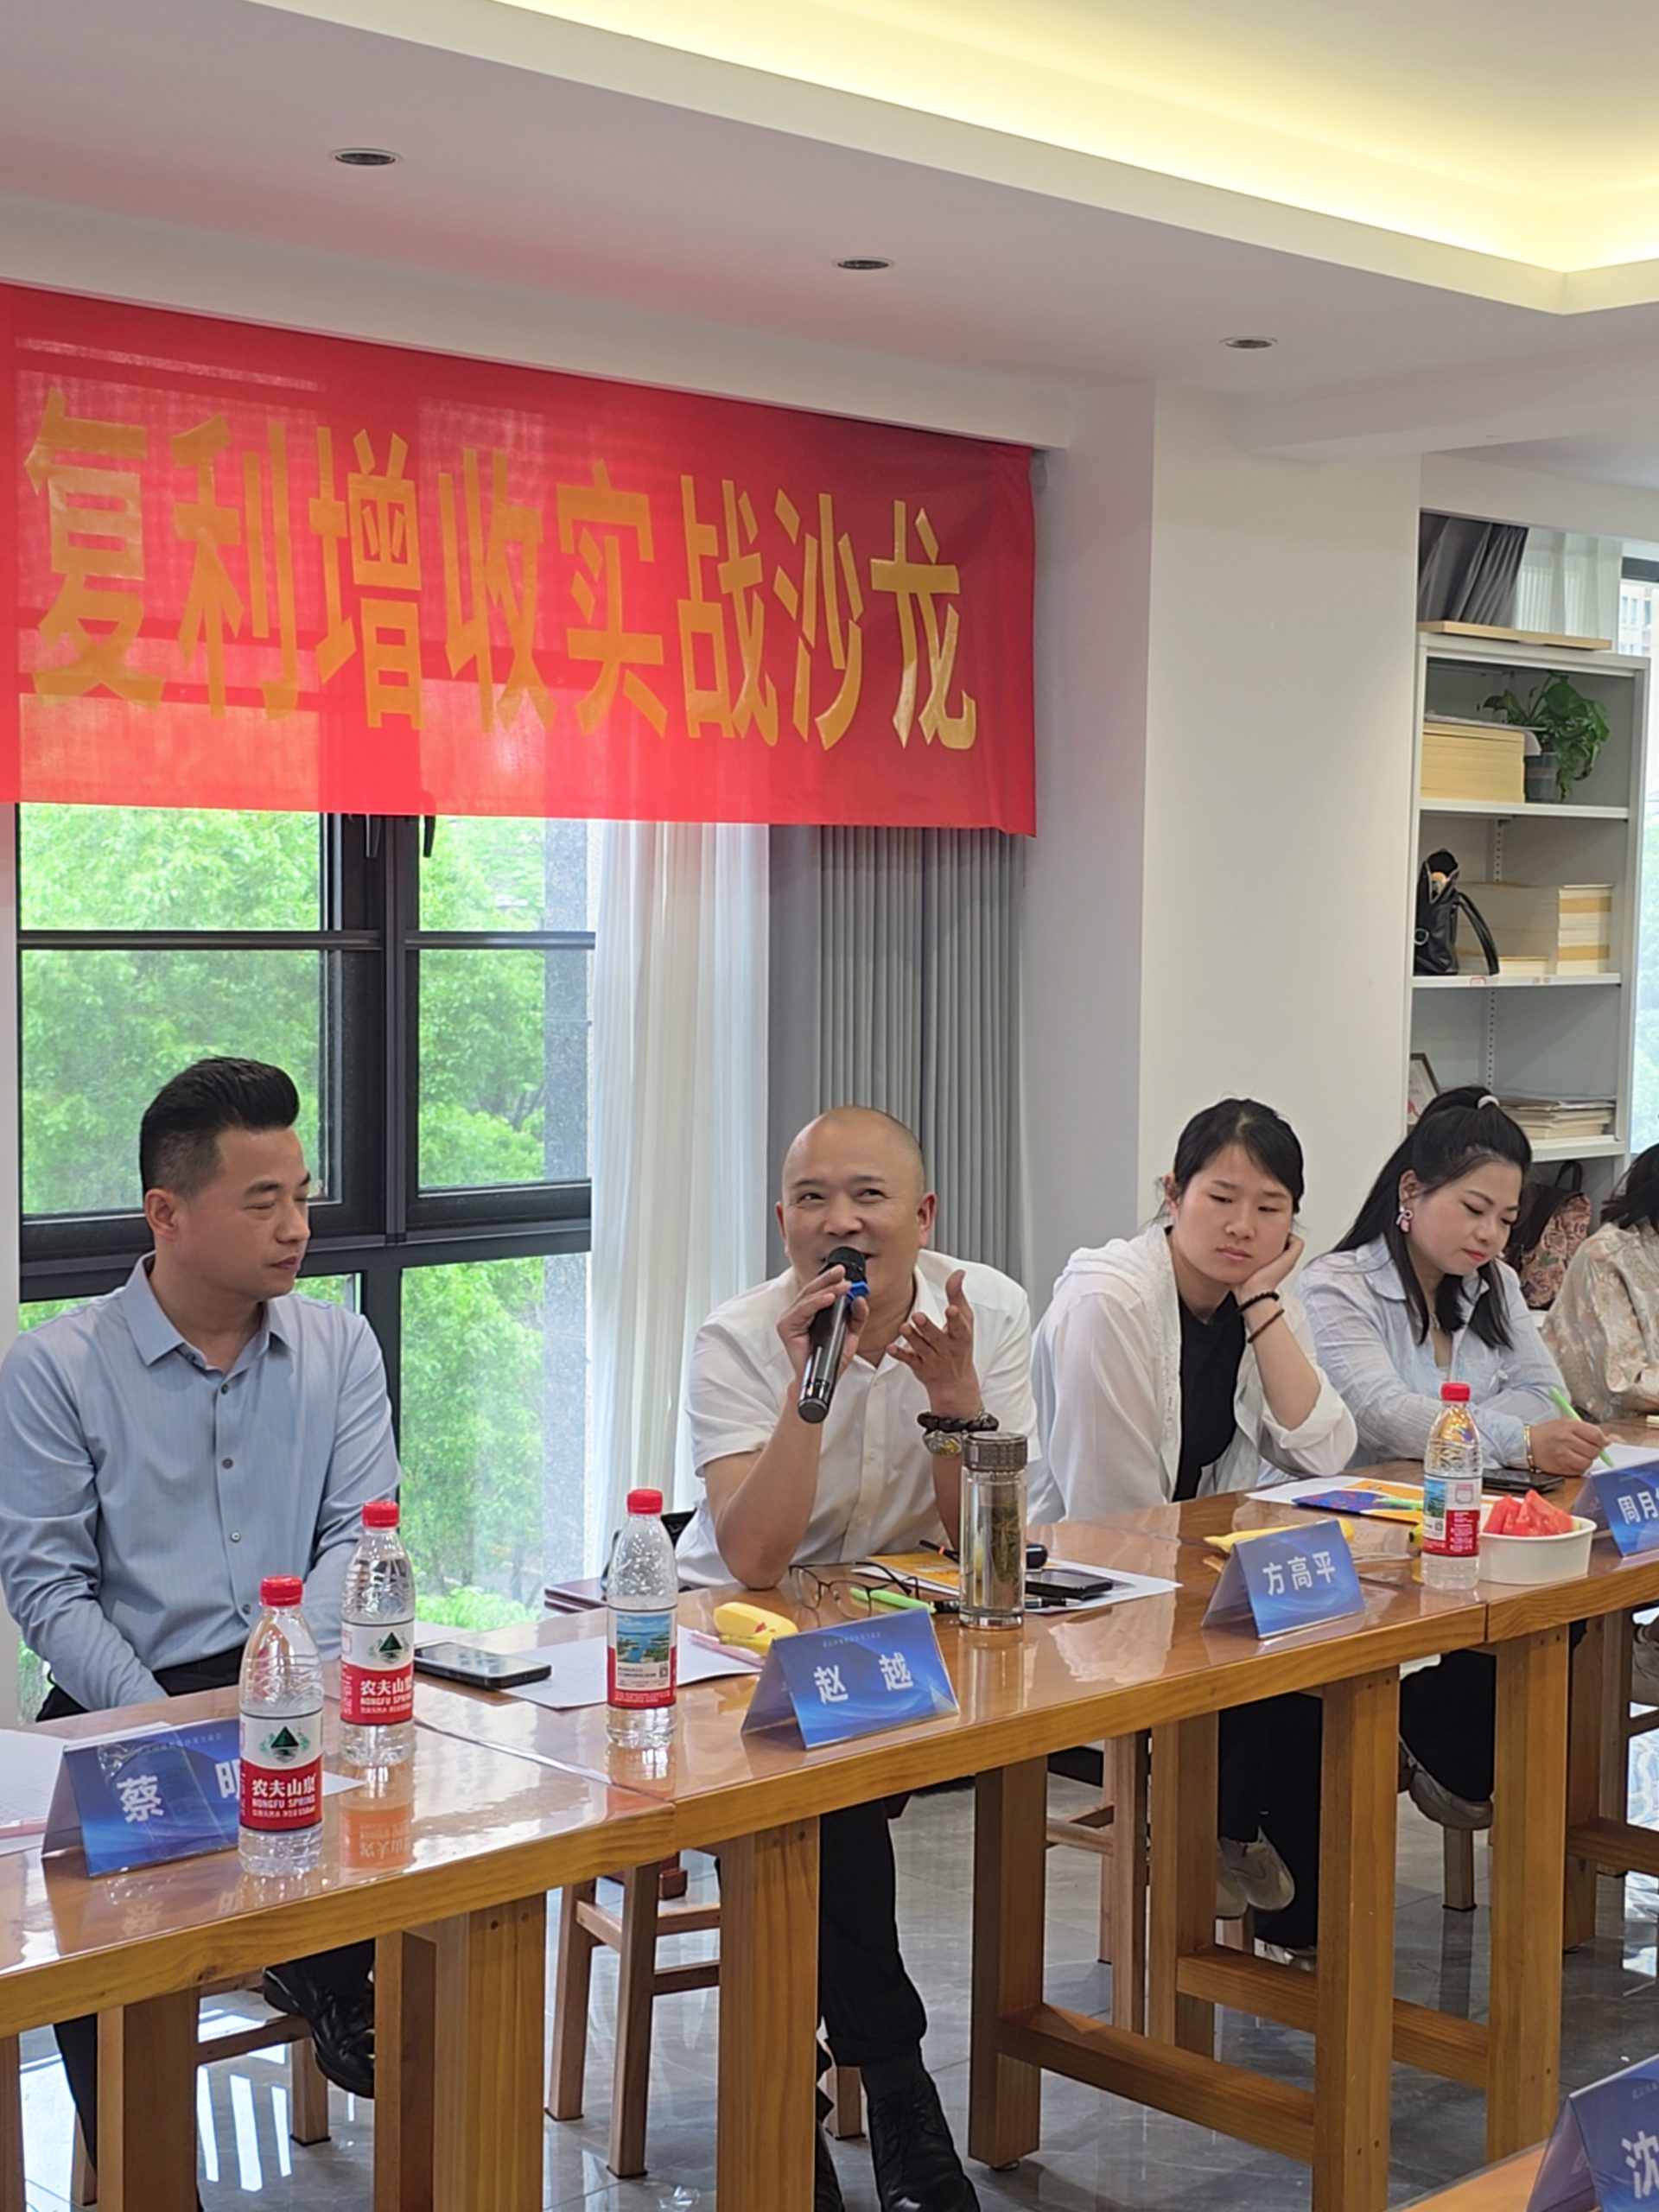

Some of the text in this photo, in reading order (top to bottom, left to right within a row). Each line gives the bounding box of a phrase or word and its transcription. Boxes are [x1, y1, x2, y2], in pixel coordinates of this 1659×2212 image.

[23, 385, 977, 750] 复利增收实战沙龙
[1618, 1487, 1659, 1525] 周月
[1262, 1551, 1336, 1596] 方高平
[251, 1773, 317, 1798] 农夫山泉
[251, 1797, 286, 1809] NONGFU
